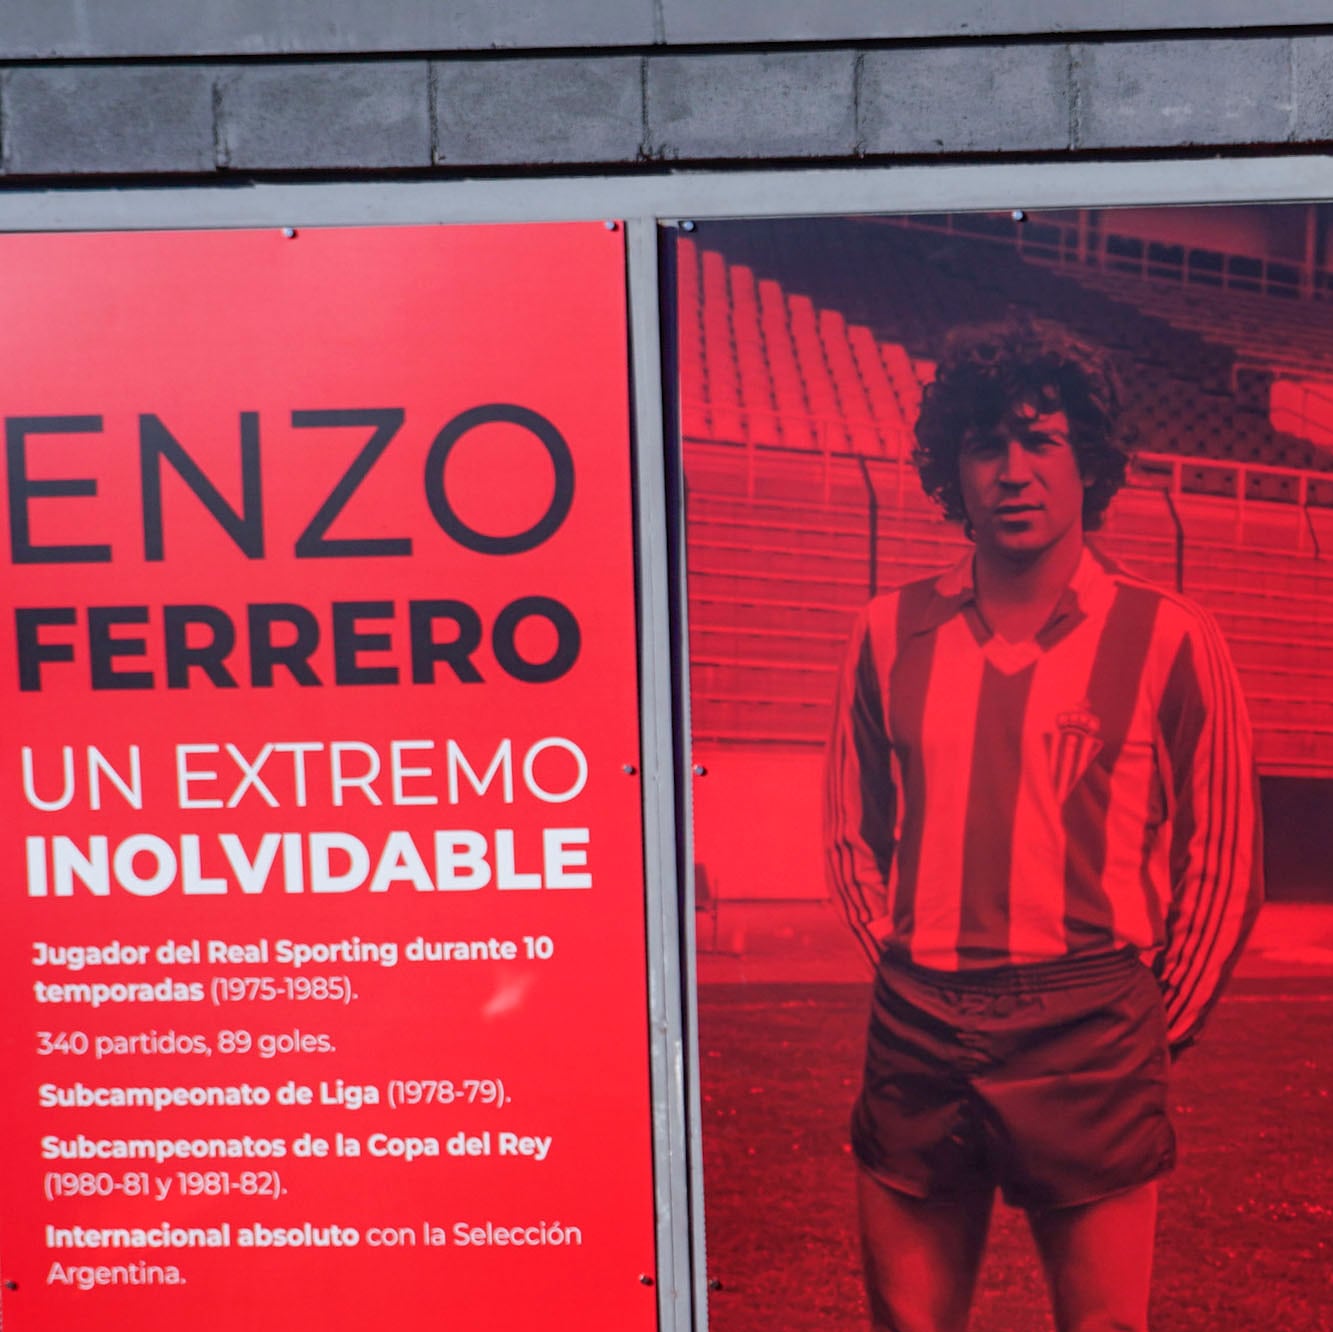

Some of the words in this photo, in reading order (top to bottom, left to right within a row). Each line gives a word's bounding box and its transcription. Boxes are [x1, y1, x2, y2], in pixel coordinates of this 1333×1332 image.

[6, 403, 574, 564] ENZO
[15, 596, 580, 691] FERRERO
[22, 746, 142, 811] UN
[176, 738, 587, 808] EXTREMO
[26, 828, 592, 896] INOLVIDABLE
[31, 941, 151, 970] Jugador
[155, 940, 201, 965] del
[207, 939, 269, 964] Real
[274, 937, 399, 968] Sporting
[404, 937, 518, 962] durante
[522, 936, 554, 960] 10
[33, 977, 205, 1008] temporadas
[210, 976, 359, 1006] (1975-1985).
[37, 1032, 89, 1056] 340
[95, 1030, 212, 1059] partidos,
[217, 1030, 252, 1054] 89
[257, 1029, 336, 1059] goles.
[38, 1083, 271, 1112] Subcampeonato
[275, 1081, 314, 1106] de
[319, 1079, 380, 1110] Liga
[387, 1079, 512, 1109] (1978-79).
[41, 1135, 287, 1164] Subcampeonatos
[291, 1133, 330, 1158] de
[335, 1133, 361, 1158] la
[366, 1133, 440, 1162] Copa
[445, 1132, 491, 1157] del
[498, 1132, 553, 1161] Rey
[44, 1173, 150, 1200] (1980-81
[155, 1178, 173, 1201] y
[177, 1172, 288, 1200] 1981-82).
[45, 1222, 231, 1248] Internacional
[236, 1223, 360, 1248] absoluto
[365, 1228, 416, 1248] con
[423, 1223, 446, 1246] la
[454, 1220, 581, 1245] Selección
[48, 1262, 185, 1289] Argentina.
